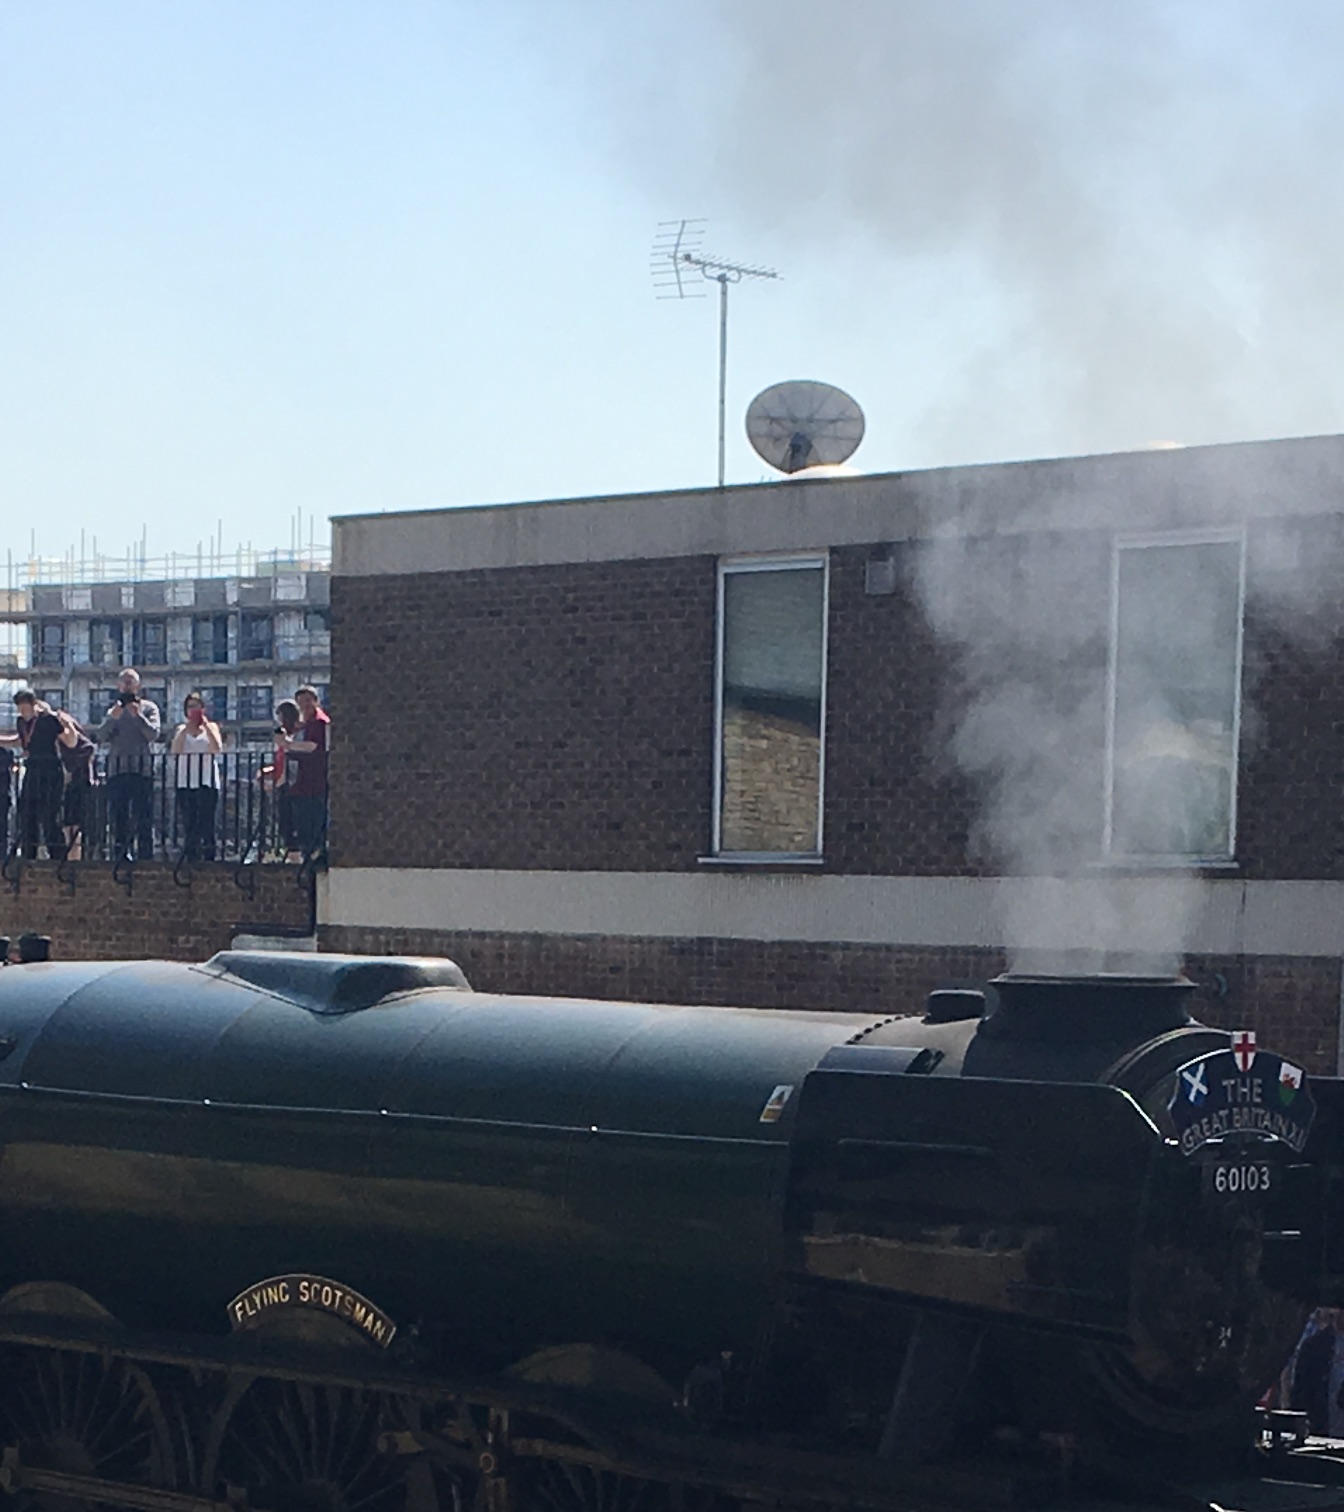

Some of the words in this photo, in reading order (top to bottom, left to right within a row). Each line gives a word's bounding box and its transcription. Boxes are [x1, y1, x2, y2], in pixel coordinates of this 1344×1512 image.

[1222, 1078, 1263, 1103] THE
[1182, 1108, 1229, 1148] GREAT
[1232, 1107, 1290, 1136] BRITAIN
[1215, 1166, 1270, 1192] 60103
[235, 1282, 290, 1323] FLYING
[299, 1281, 386, 1341] SCOTSMAN
